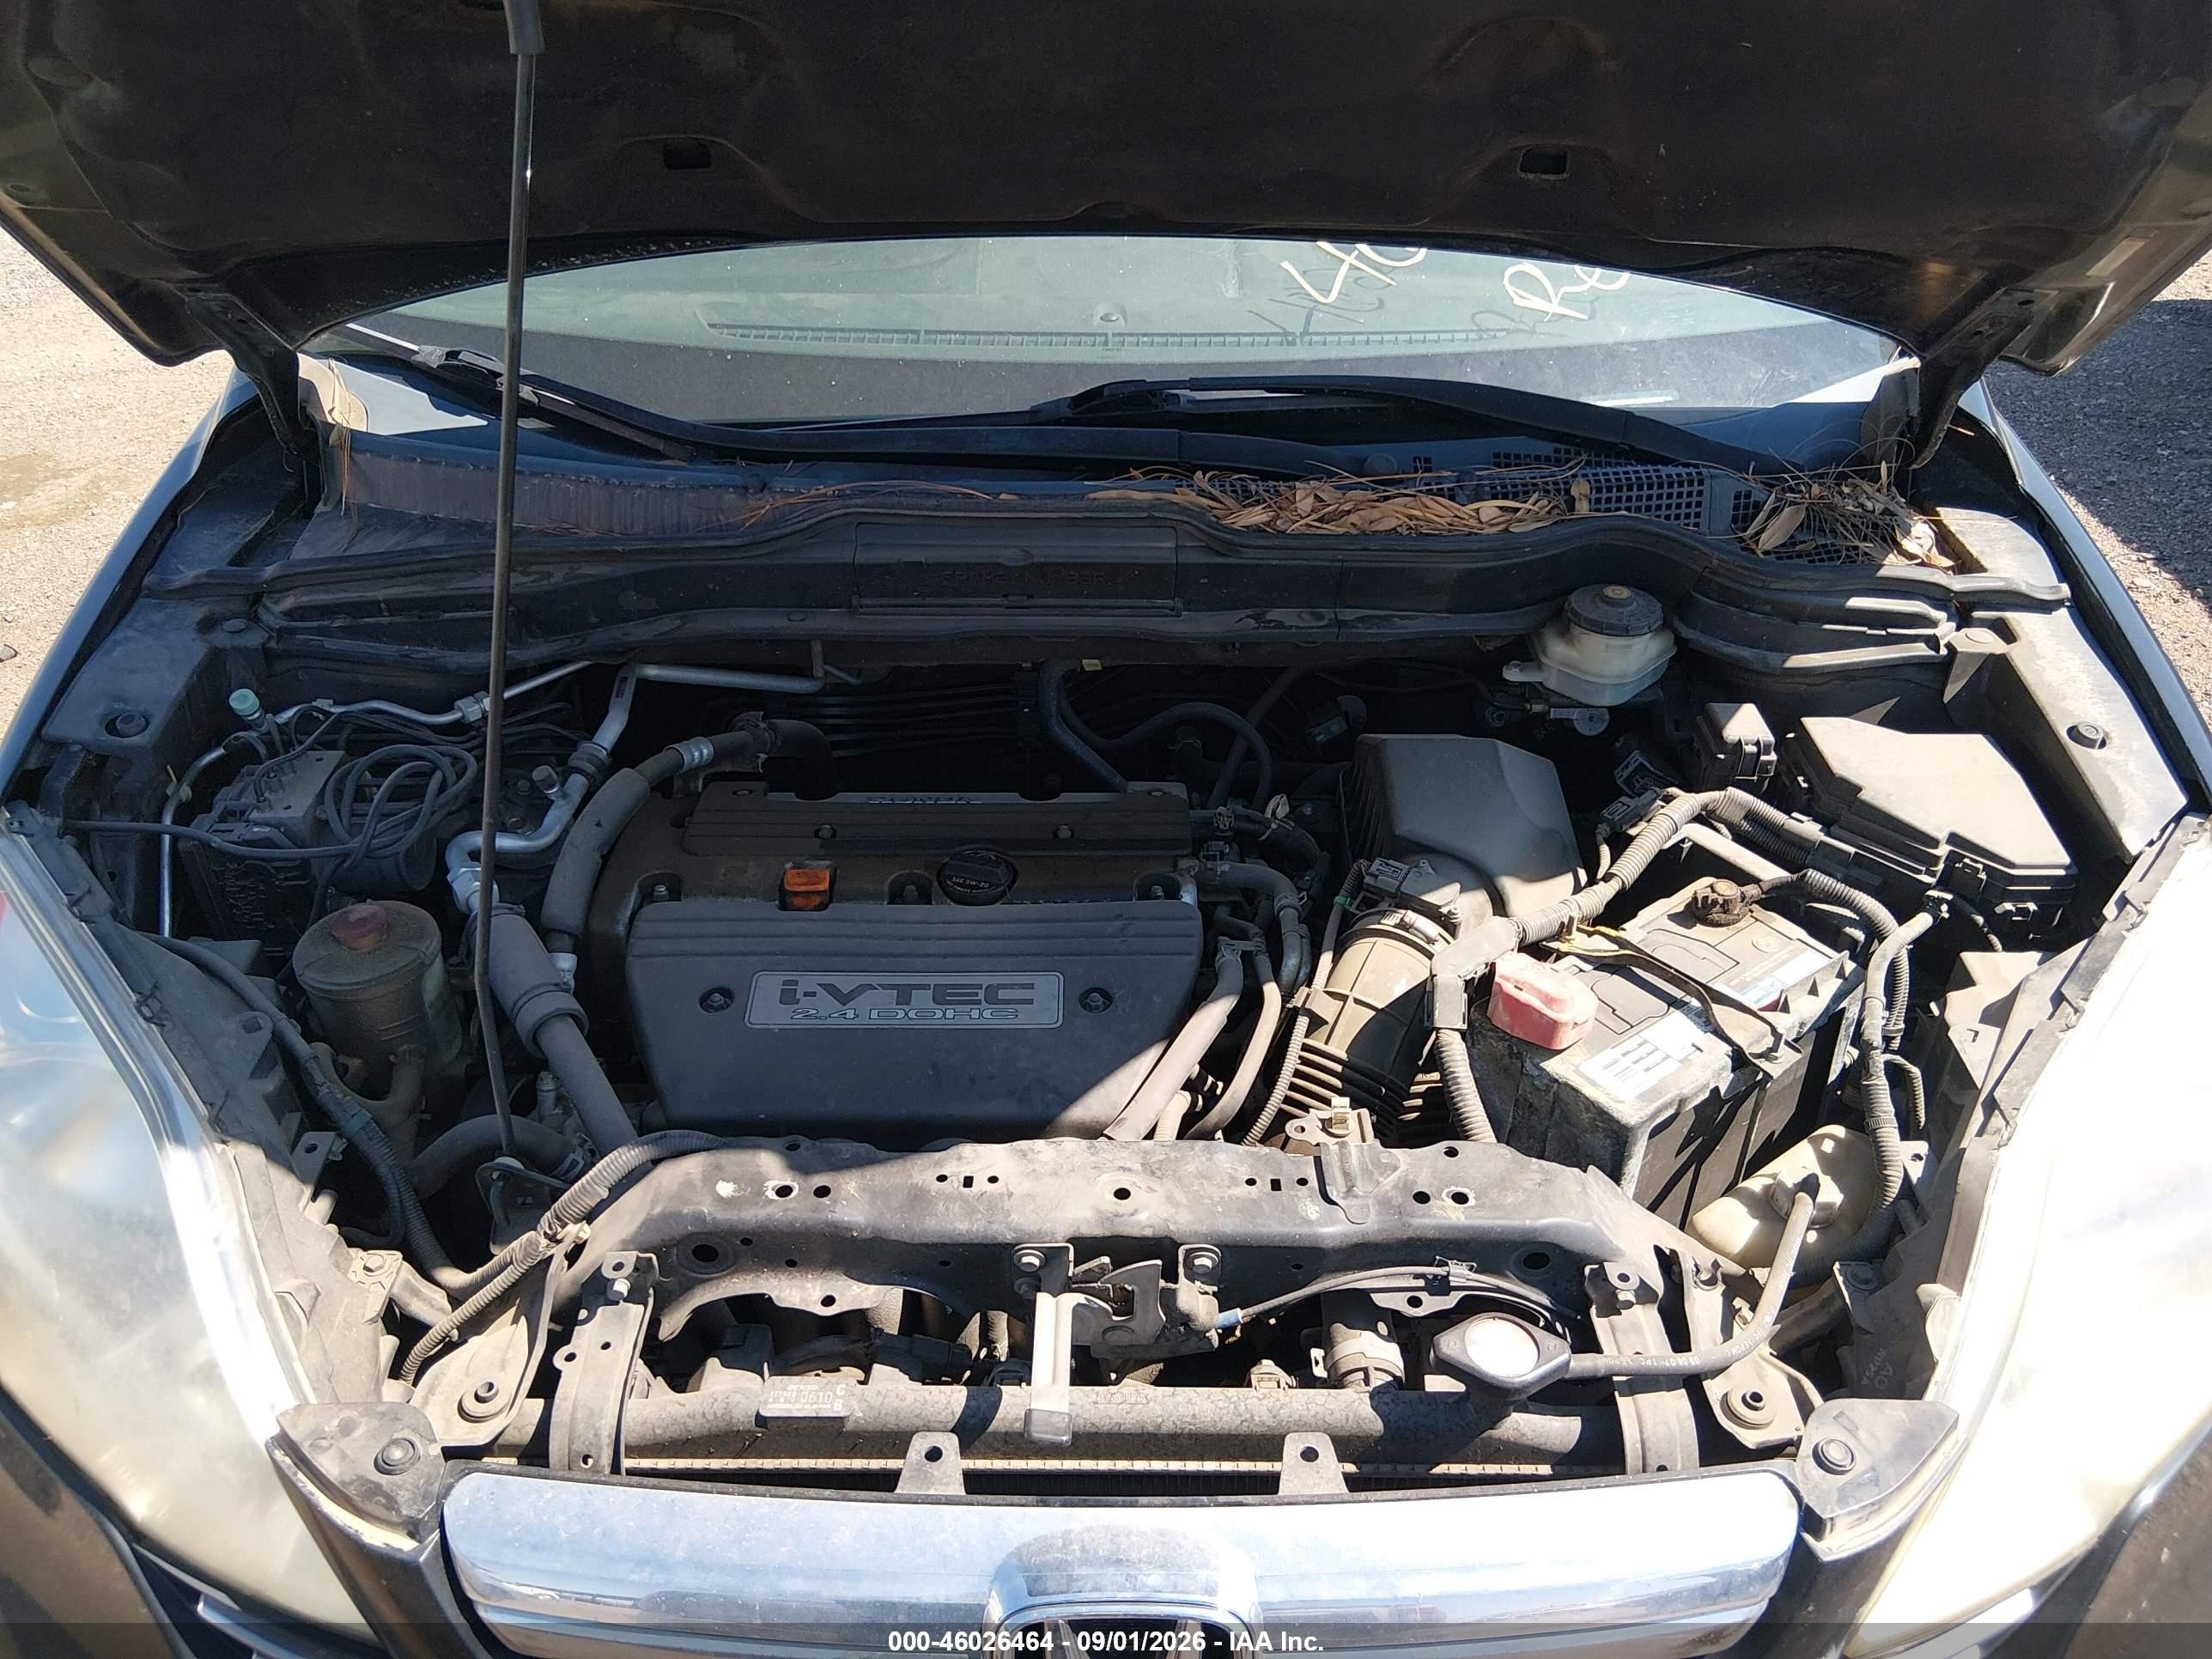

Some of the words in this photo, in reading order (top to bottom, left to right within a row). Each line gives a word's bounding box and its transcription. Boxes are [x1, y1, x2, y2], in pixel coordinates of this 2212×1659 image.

[779, 978, 1035, 1006] i-VTEC
[791, 1007, 859, 1021] 2.4
[869, 1007, 1018, 1021] DOHC
